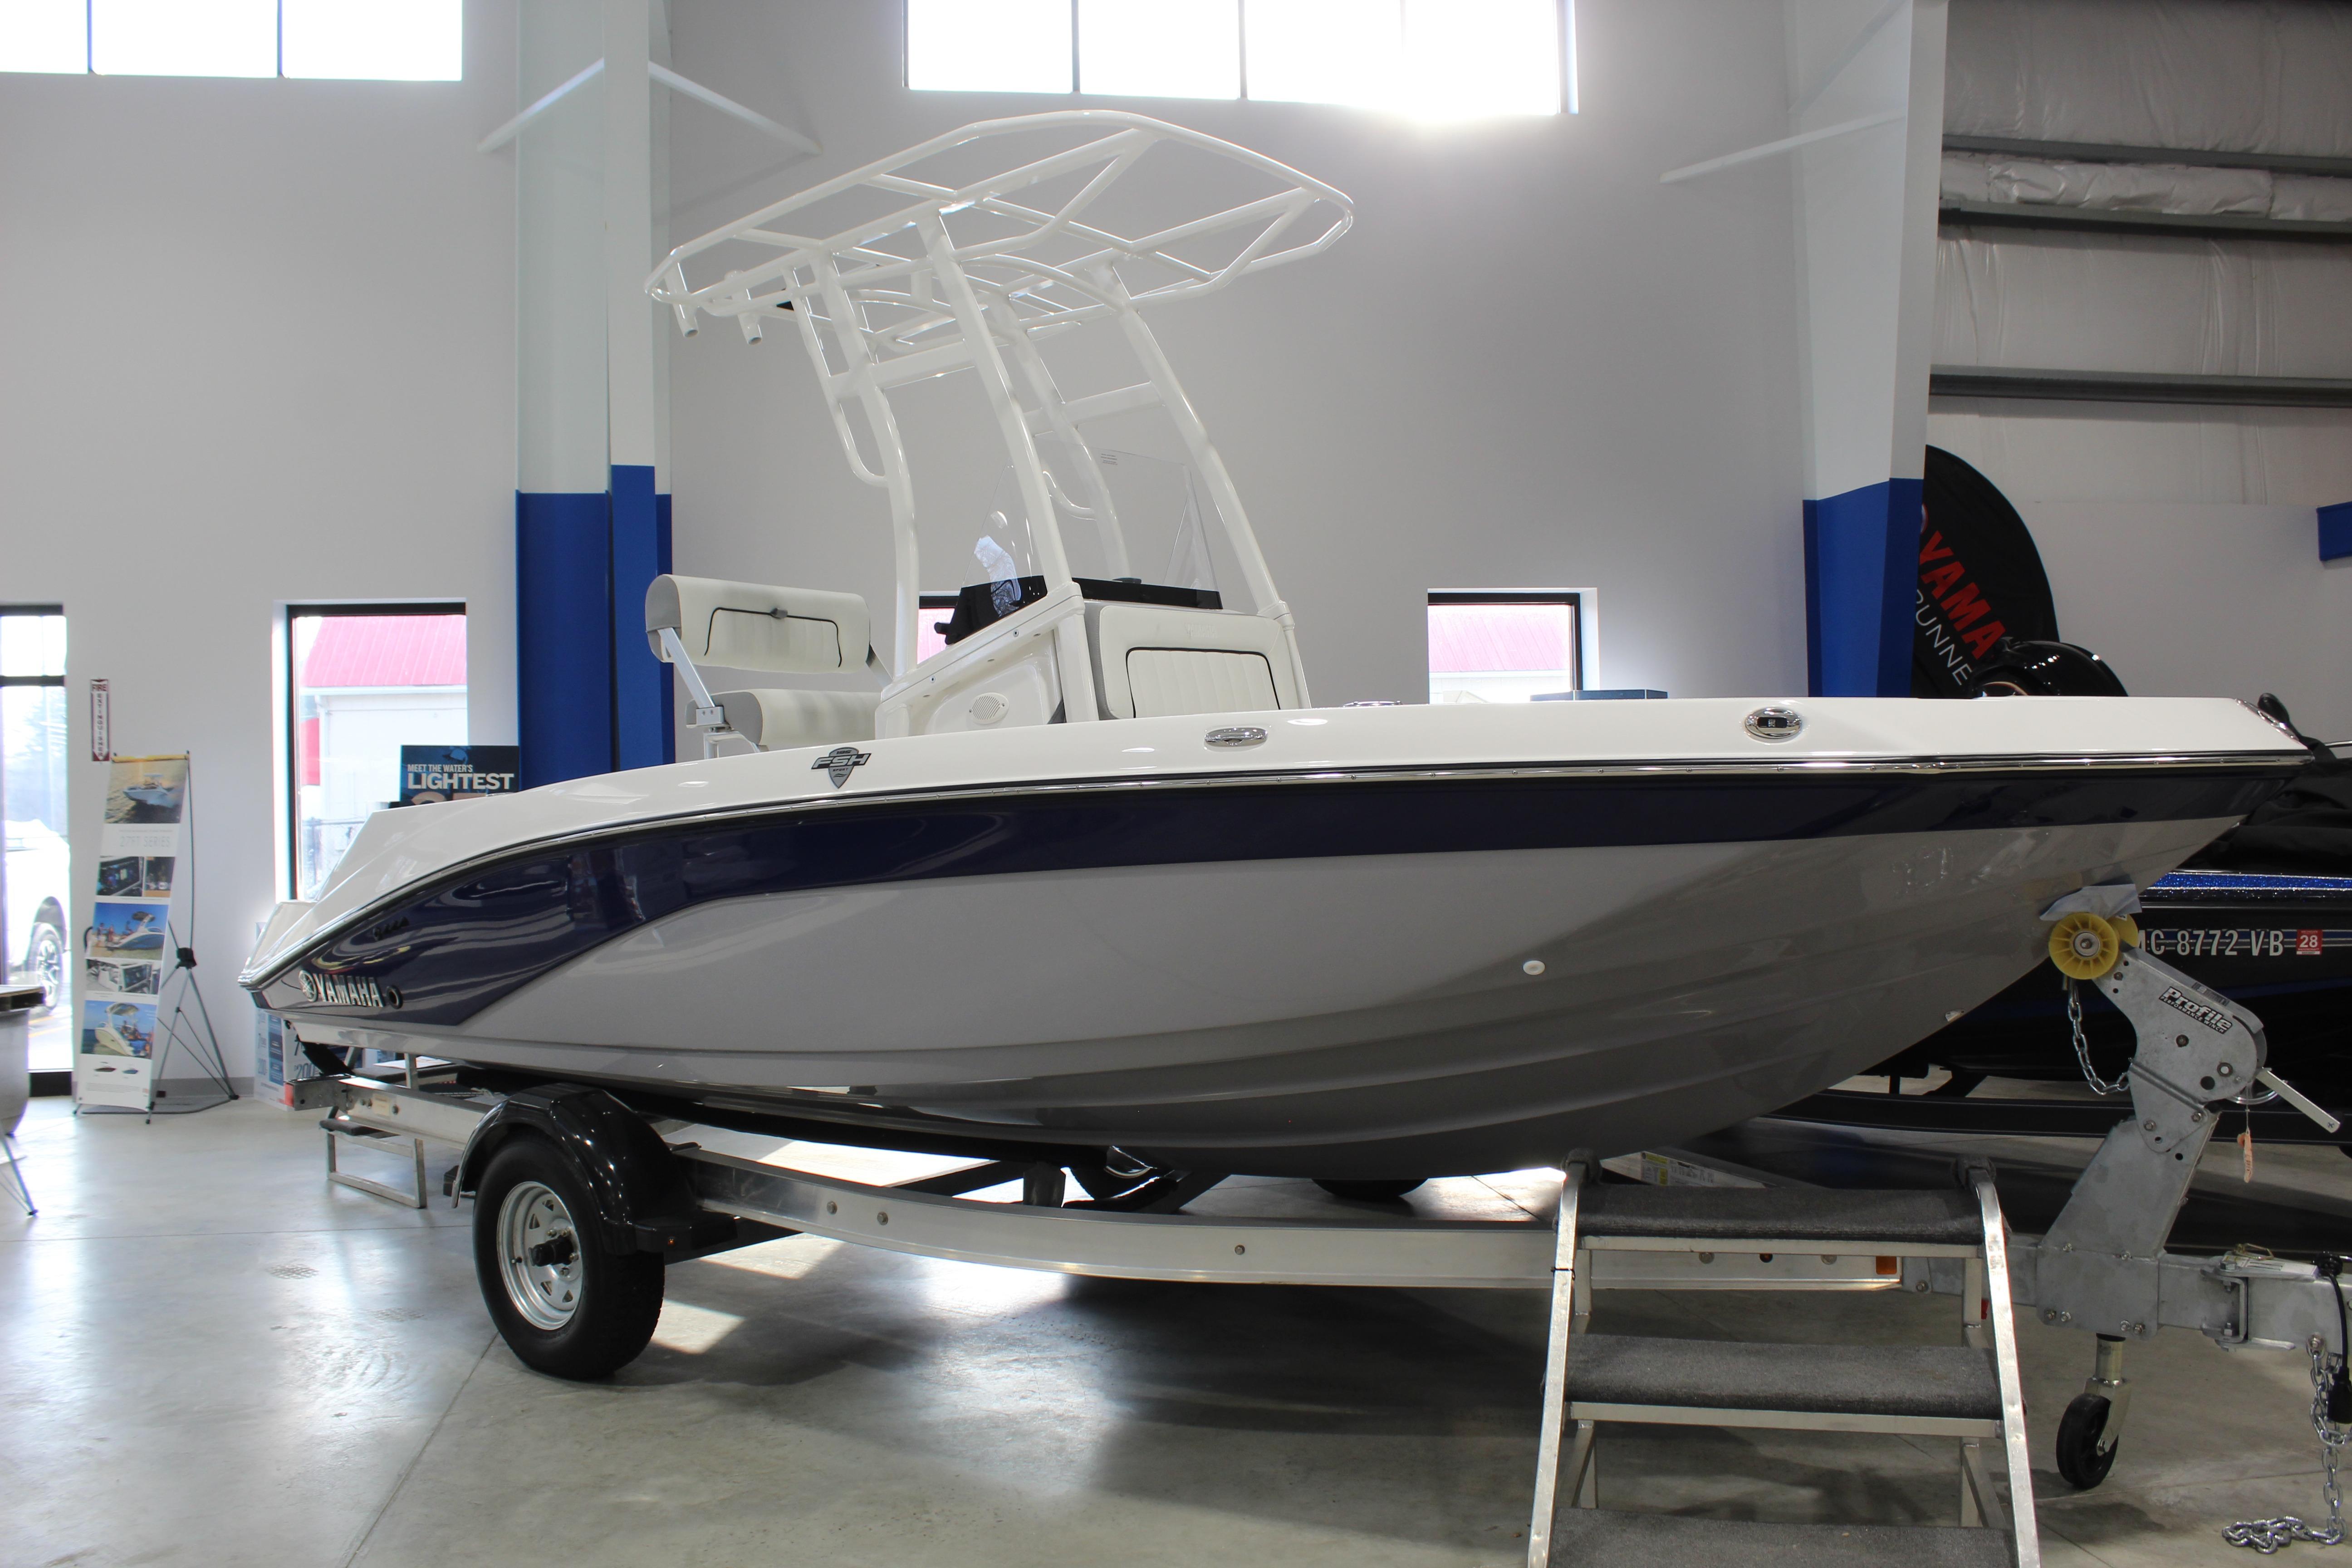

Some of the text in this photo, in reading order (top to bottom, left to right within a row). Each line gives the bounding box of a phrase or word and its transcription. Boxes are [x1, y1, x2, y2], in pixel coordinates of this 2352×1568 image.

[443, 764, 473, 773] WATER'S
[812, 754, 870, 769] FSH
[408, 773, 514, 789] LIGHTEST
[2177, 930, 2238, 956] 8772
[2251, 931, 2283, 956] VB
[2299, 935, 2318, 948] 28
[313, 973, 384, 1008] YAMAHA
[2160, 996, 2224, 1033] PERFORMANCE WINCH
[2163, 987, 2231, 1030] Profile
